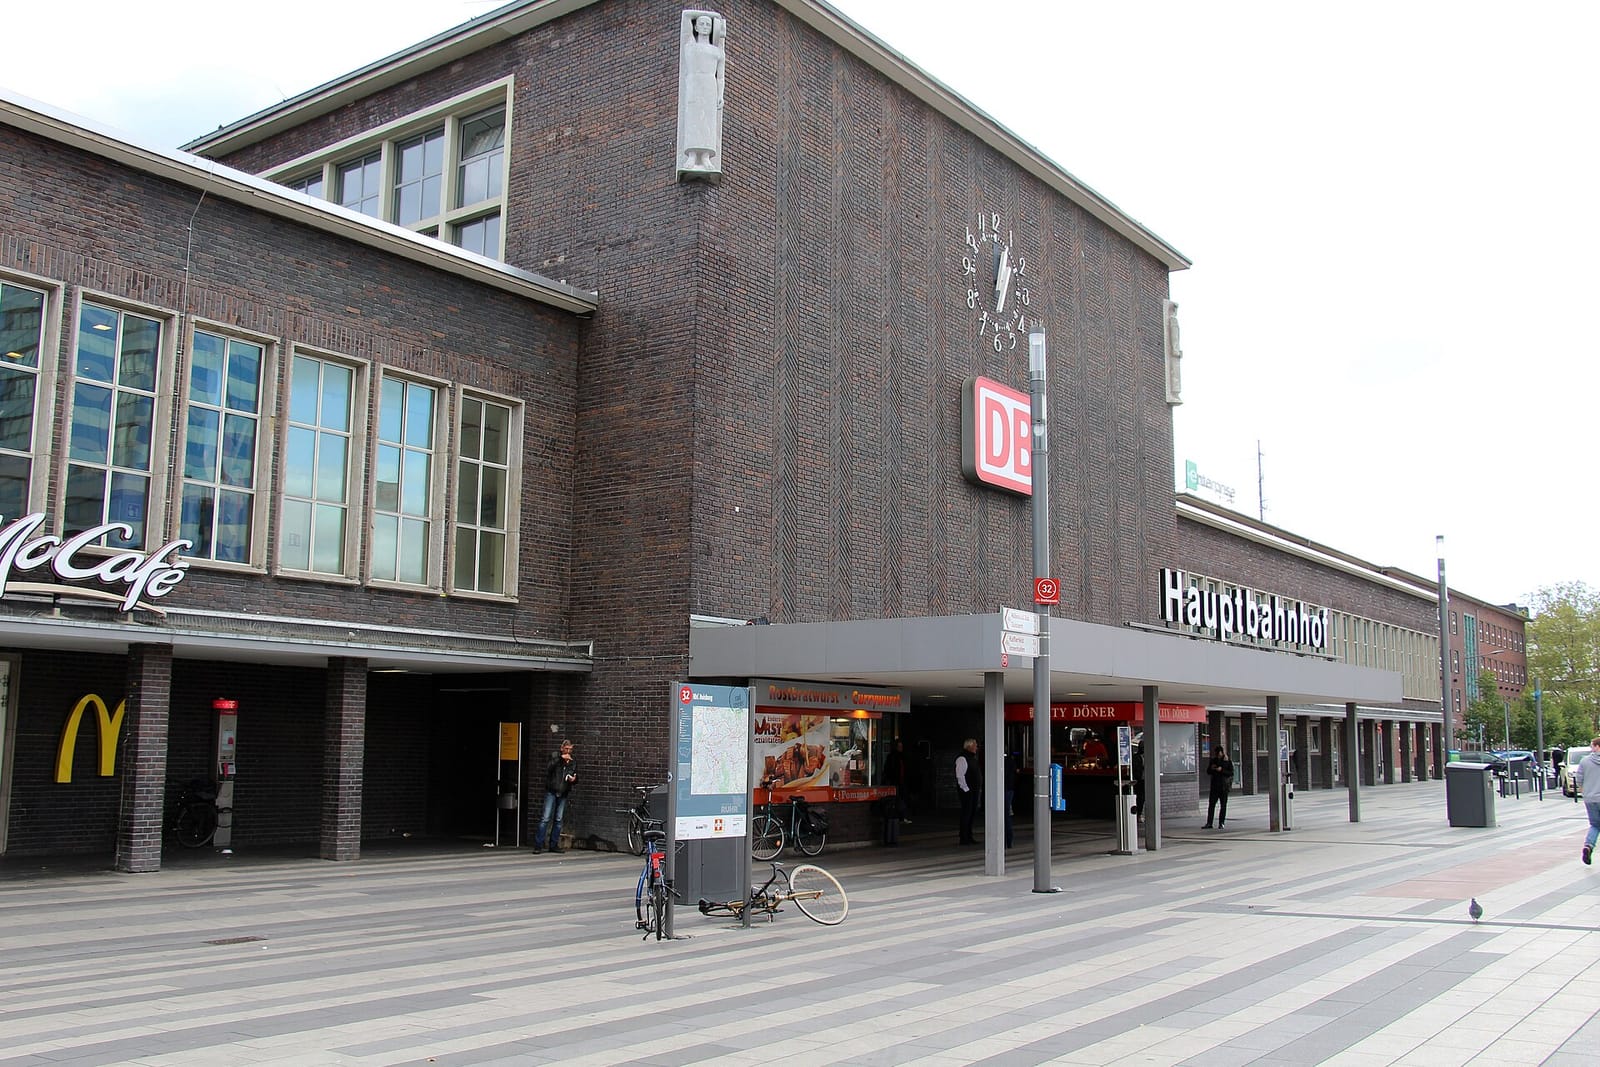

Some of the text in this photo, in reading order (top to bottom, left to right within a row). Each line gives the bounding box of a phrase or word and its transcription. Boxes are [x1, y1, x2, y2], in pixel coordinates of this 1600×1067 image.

[992, 211, 1000, 233] 12
[966, 226, 976, 247] 10
[1009, 230, 1013, 247] 1
[962, 256, 971, 276] 9
[1019, 257, 1026, 277] 2
[967, 288, 975, 309] 8
[1022, 287, 1030, 306] 3
[979, 317, 987, 336] 7
[1017, 314, 1026, 335] 4
[994, 333, 1002, 353] 6
[1009, 332, 1017, 350] 5
[985, 396, 1032, 478] DB
[1041, 584, 1053, 594] 32
[1159, 567, 1330, 648] Hauptbahnhof
[681, 689, 691, 701] 32
[768, 684, 902, 709] Rostbratwurst Currywurst
[1073, 704, 1115, 718] DÖNER
[1172, 706, 1190, 720] DÖNER
